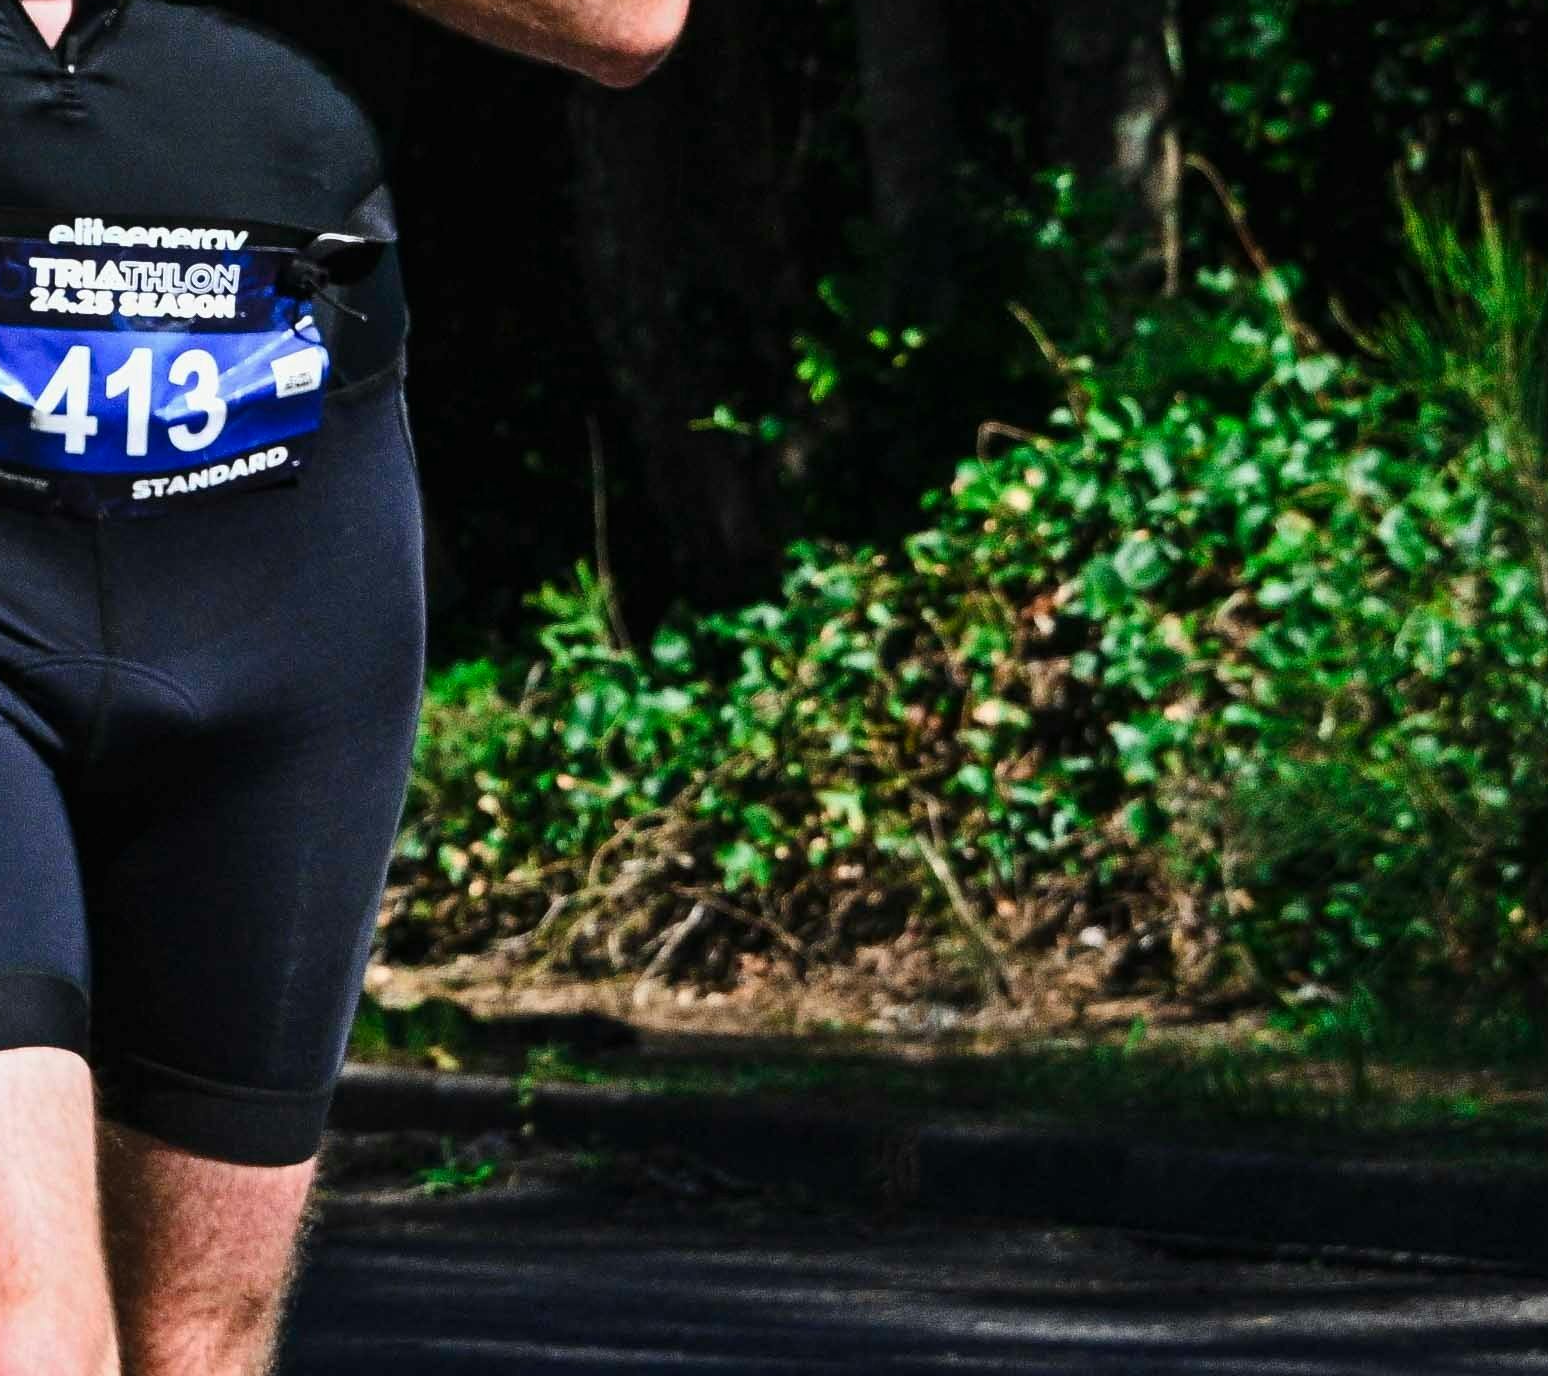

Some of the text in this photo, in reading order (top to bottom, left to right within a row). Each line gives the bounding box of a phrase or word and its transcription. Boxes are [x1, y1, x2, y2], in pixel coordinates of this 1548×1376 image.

[29, 257, 241, 294] TRIATHLON
[119, 292, 237, 318] SEASON
[30, 344, 228, 457] 413
[132, 445, 288, 500] STANDARD
